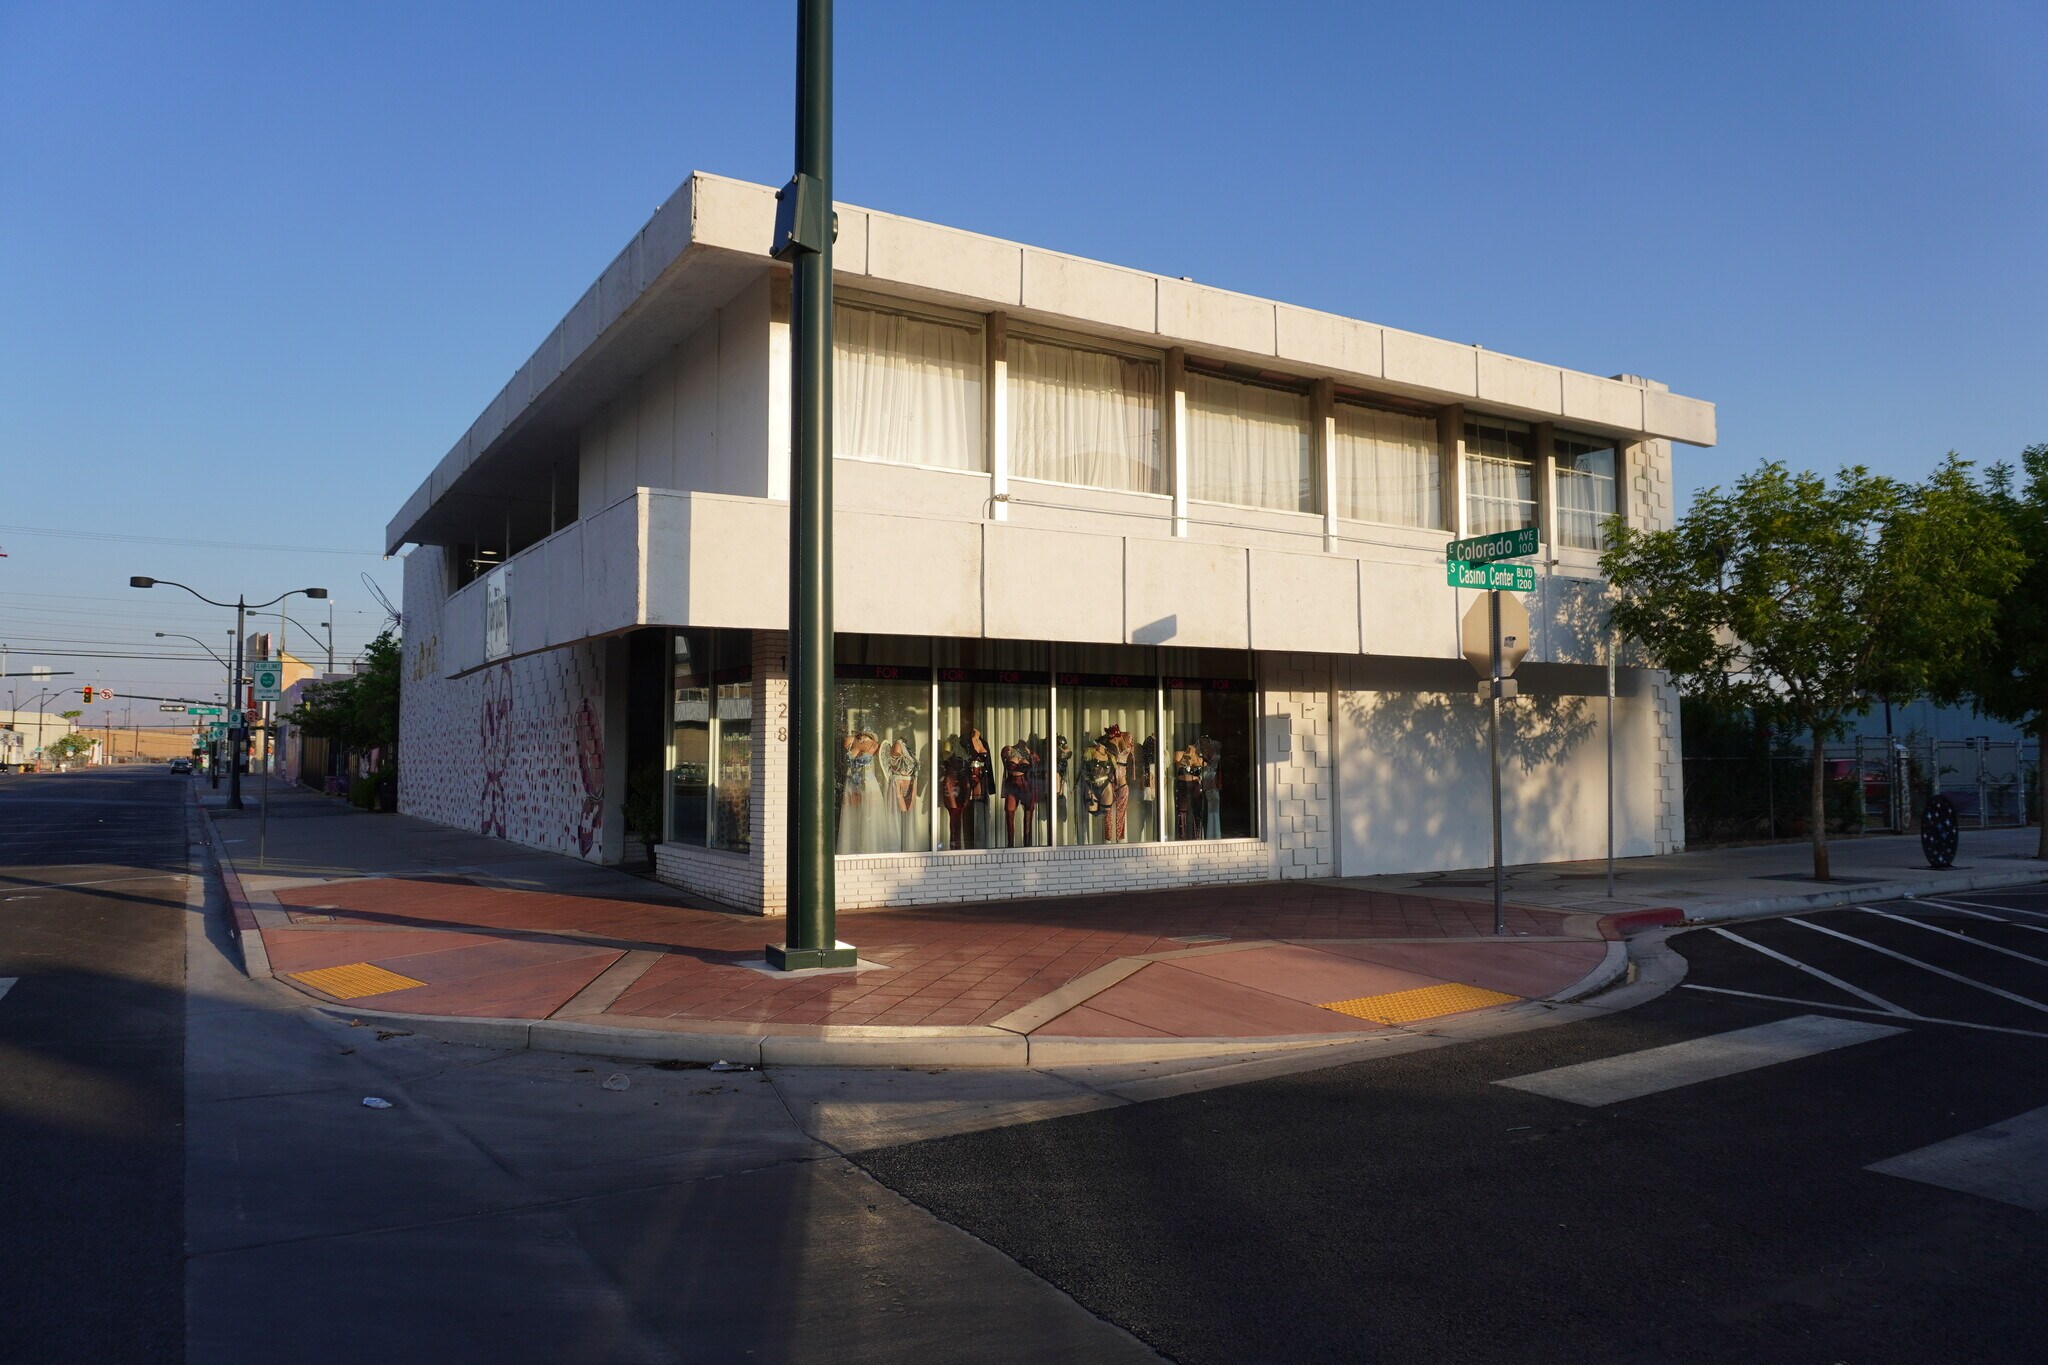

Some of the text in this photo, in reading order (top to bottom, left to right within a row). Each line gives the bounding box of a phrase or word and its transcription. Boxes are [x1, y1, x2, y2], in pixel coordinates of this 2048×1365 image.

[1518, 530, 1534, 542] AVE
[1449, 537, 1513, 561] E Colorado
[1519, 542, 1534, 554] 100
[1450, 563, 1515, 587] S Casino Center
[1516, 567, 1533, 578] BLVD
[1516, 579, 1533, 590] 1200
[876, 667, 898, 679] FOR
[943, 669, 964, 681] FOR
[999, 671, 1020, 682] FOR
